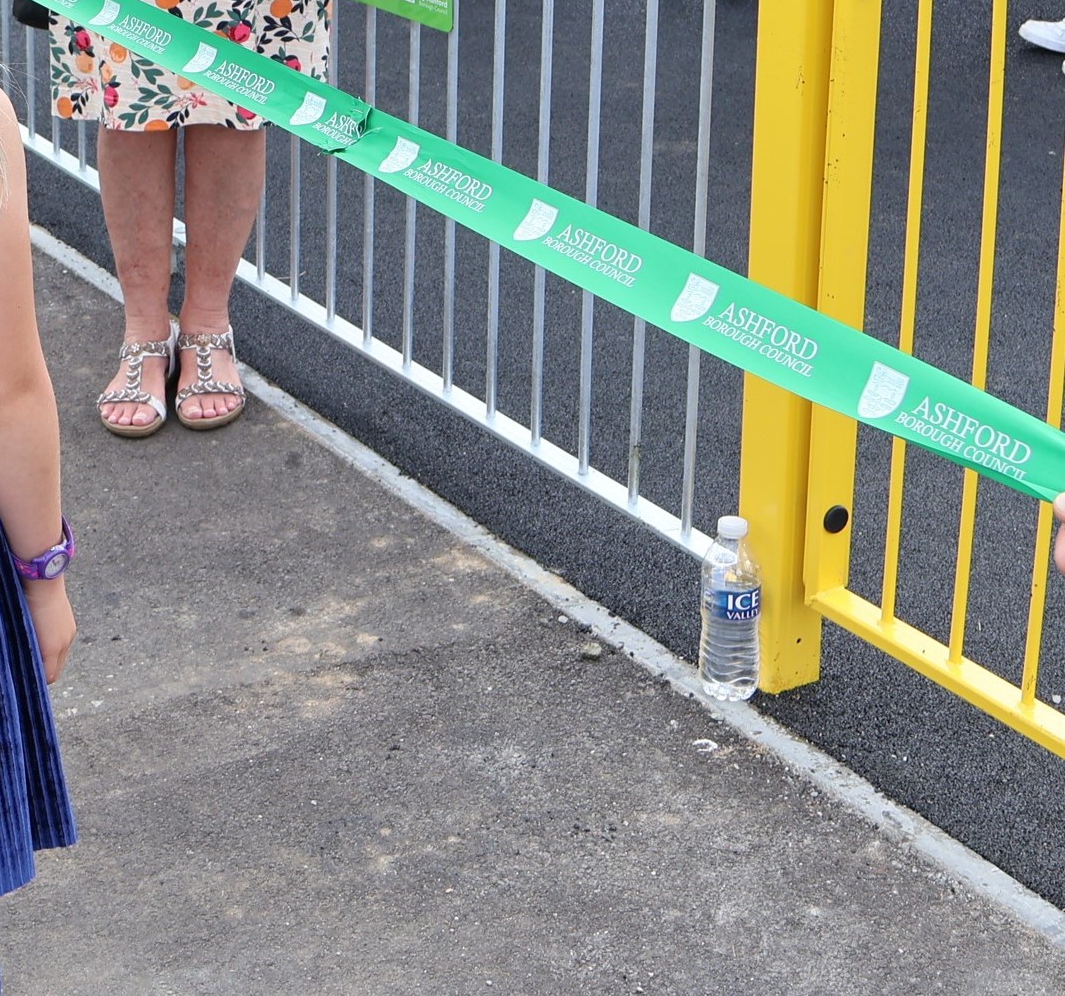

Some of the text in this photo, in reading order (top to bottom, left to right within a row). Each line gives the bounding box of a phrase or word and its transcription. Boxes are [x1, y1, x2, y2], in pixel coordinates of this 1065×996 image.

[118, 14, 172, 46] ASHFORD
[203, 70, 268, 105] BOROUGH COUNCIL
[215, 60, 275, 95] ASHFORD
[403, 168, 486, 213] BOROUGH COUNCIL
[417, 158, 494, 202] ASHFORD
[541, 236, 636, 288] BOROUGH COUNCIL
[556, 223, 642, 273] ASHFORD
[702, 316, 814, 378] BOROUGH COUNCIL
[718, 302, 818, 360] ASHFORD
[895, 411, 965, 452] BOROUGH
[912, 396, 1031, 464] ASHFORD
[727, 589, 759, 611] ICE
